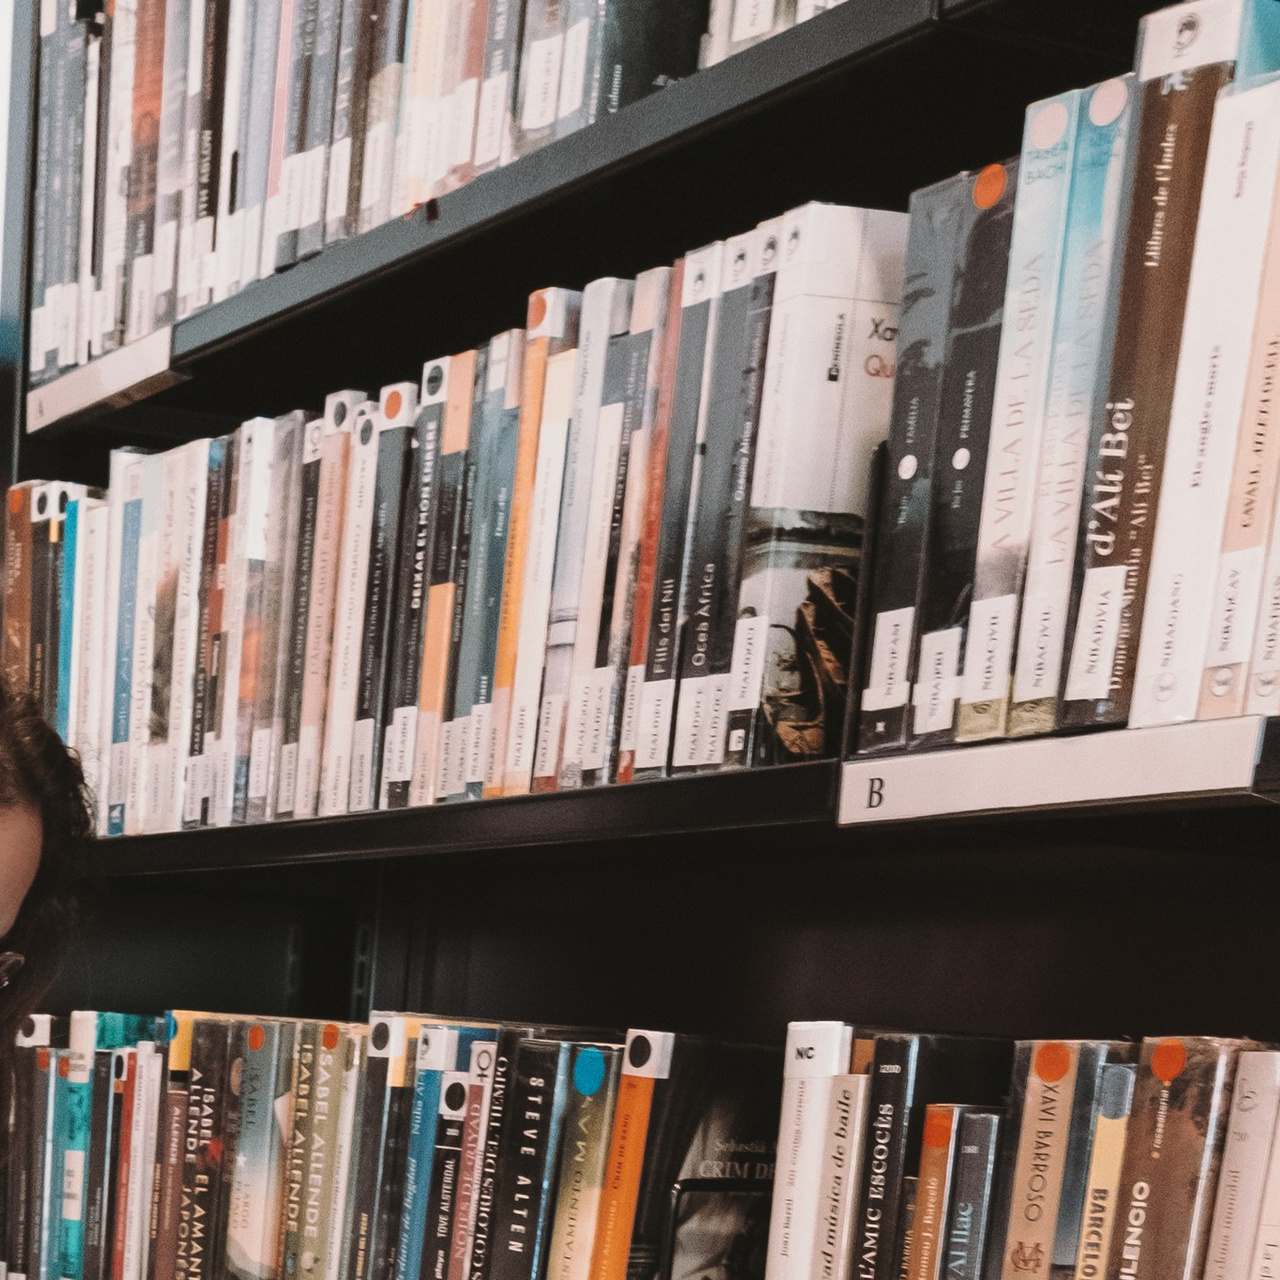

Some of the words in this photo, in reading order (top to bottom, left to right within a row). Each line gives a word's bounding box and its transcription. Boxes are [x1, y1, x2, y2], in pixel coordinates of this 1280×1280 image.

[1144, 212, 1167, 266] Llibres
[1100, 397, 1135, 458] Bei
[412, 551, 424, 609] DEIXAR
[867, 778, 884, 809] B
[185, 1067, 203, 1164] ALLENDE
[199, 1087, 216, 1151] ISABEL
[295, 1043, 314, 1122] ISABEL
[520, 1075, 546, 1156] STEVE
[835, 1090, 852, 1140] baile
[1038, 1084, 1060, 1123] XAVI
[285, 1128, 307, 1234] ALLENDE
[304, 1133, 325, 1239] ALLENDE
[473, 1176, 495, 1271] COLORES
[489, 1057, 509, 1126] TIEMPO
[834, 1152, 845, 1171] de
[869, 1103, 894, 1200] ESCOCÈS
[1024, 1130, 1054, 1222] BARROSO
[436, 1211, 448, 1237] TOVE
[442, 1159, 455, 1208] ALSTERDAL
[508, 1175, 533, 1253] ALTEN
[824, 1182, 843, 1248] música
